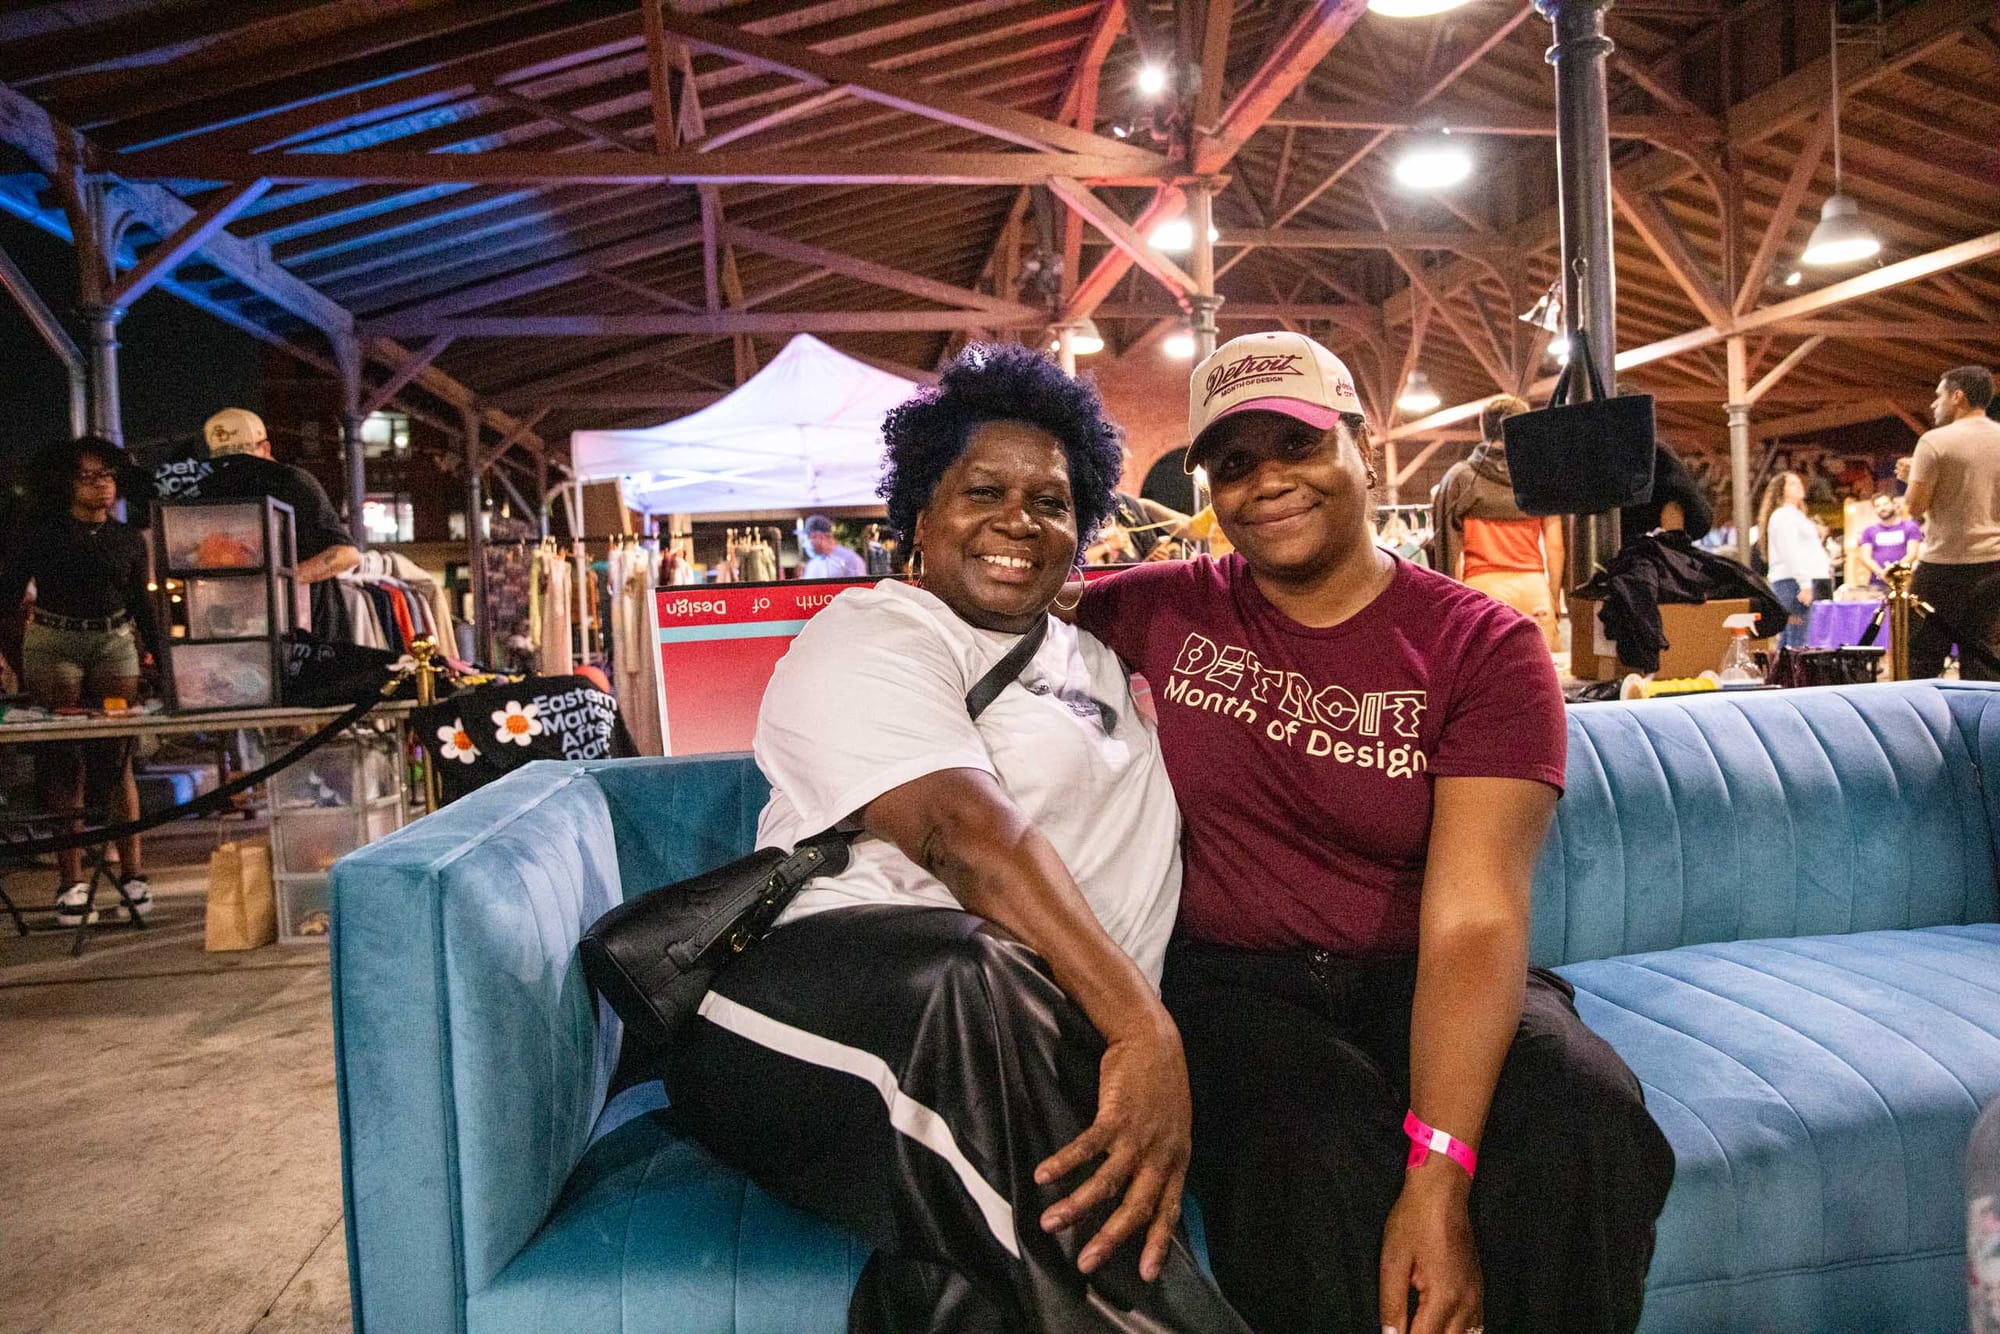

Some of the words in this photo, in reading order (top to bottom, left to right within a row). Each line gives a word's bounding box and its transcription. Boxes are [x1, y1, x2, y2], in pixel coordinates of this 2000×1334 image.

[1204, 354, 1304, 407] Detroit
[1221, 381, 1245, 397] MONTH
[1245, 378, 1256, 386] OF
[1256, 376, 1283, 384] DESIGN
[666, 598, 727, 618] Design
[752, 597, 771, 614] of
[796, 594, 835, 611] onth
[1173, 632, 1427, 738] DETROIT
[533, 687, 617, 716] Eastern
[540, 702, 616, 737] Market
[1164, 675, 1257, 724] Month
[1266, 719, 1301, 747] of
[1306, 730, 1428, 779] Design
